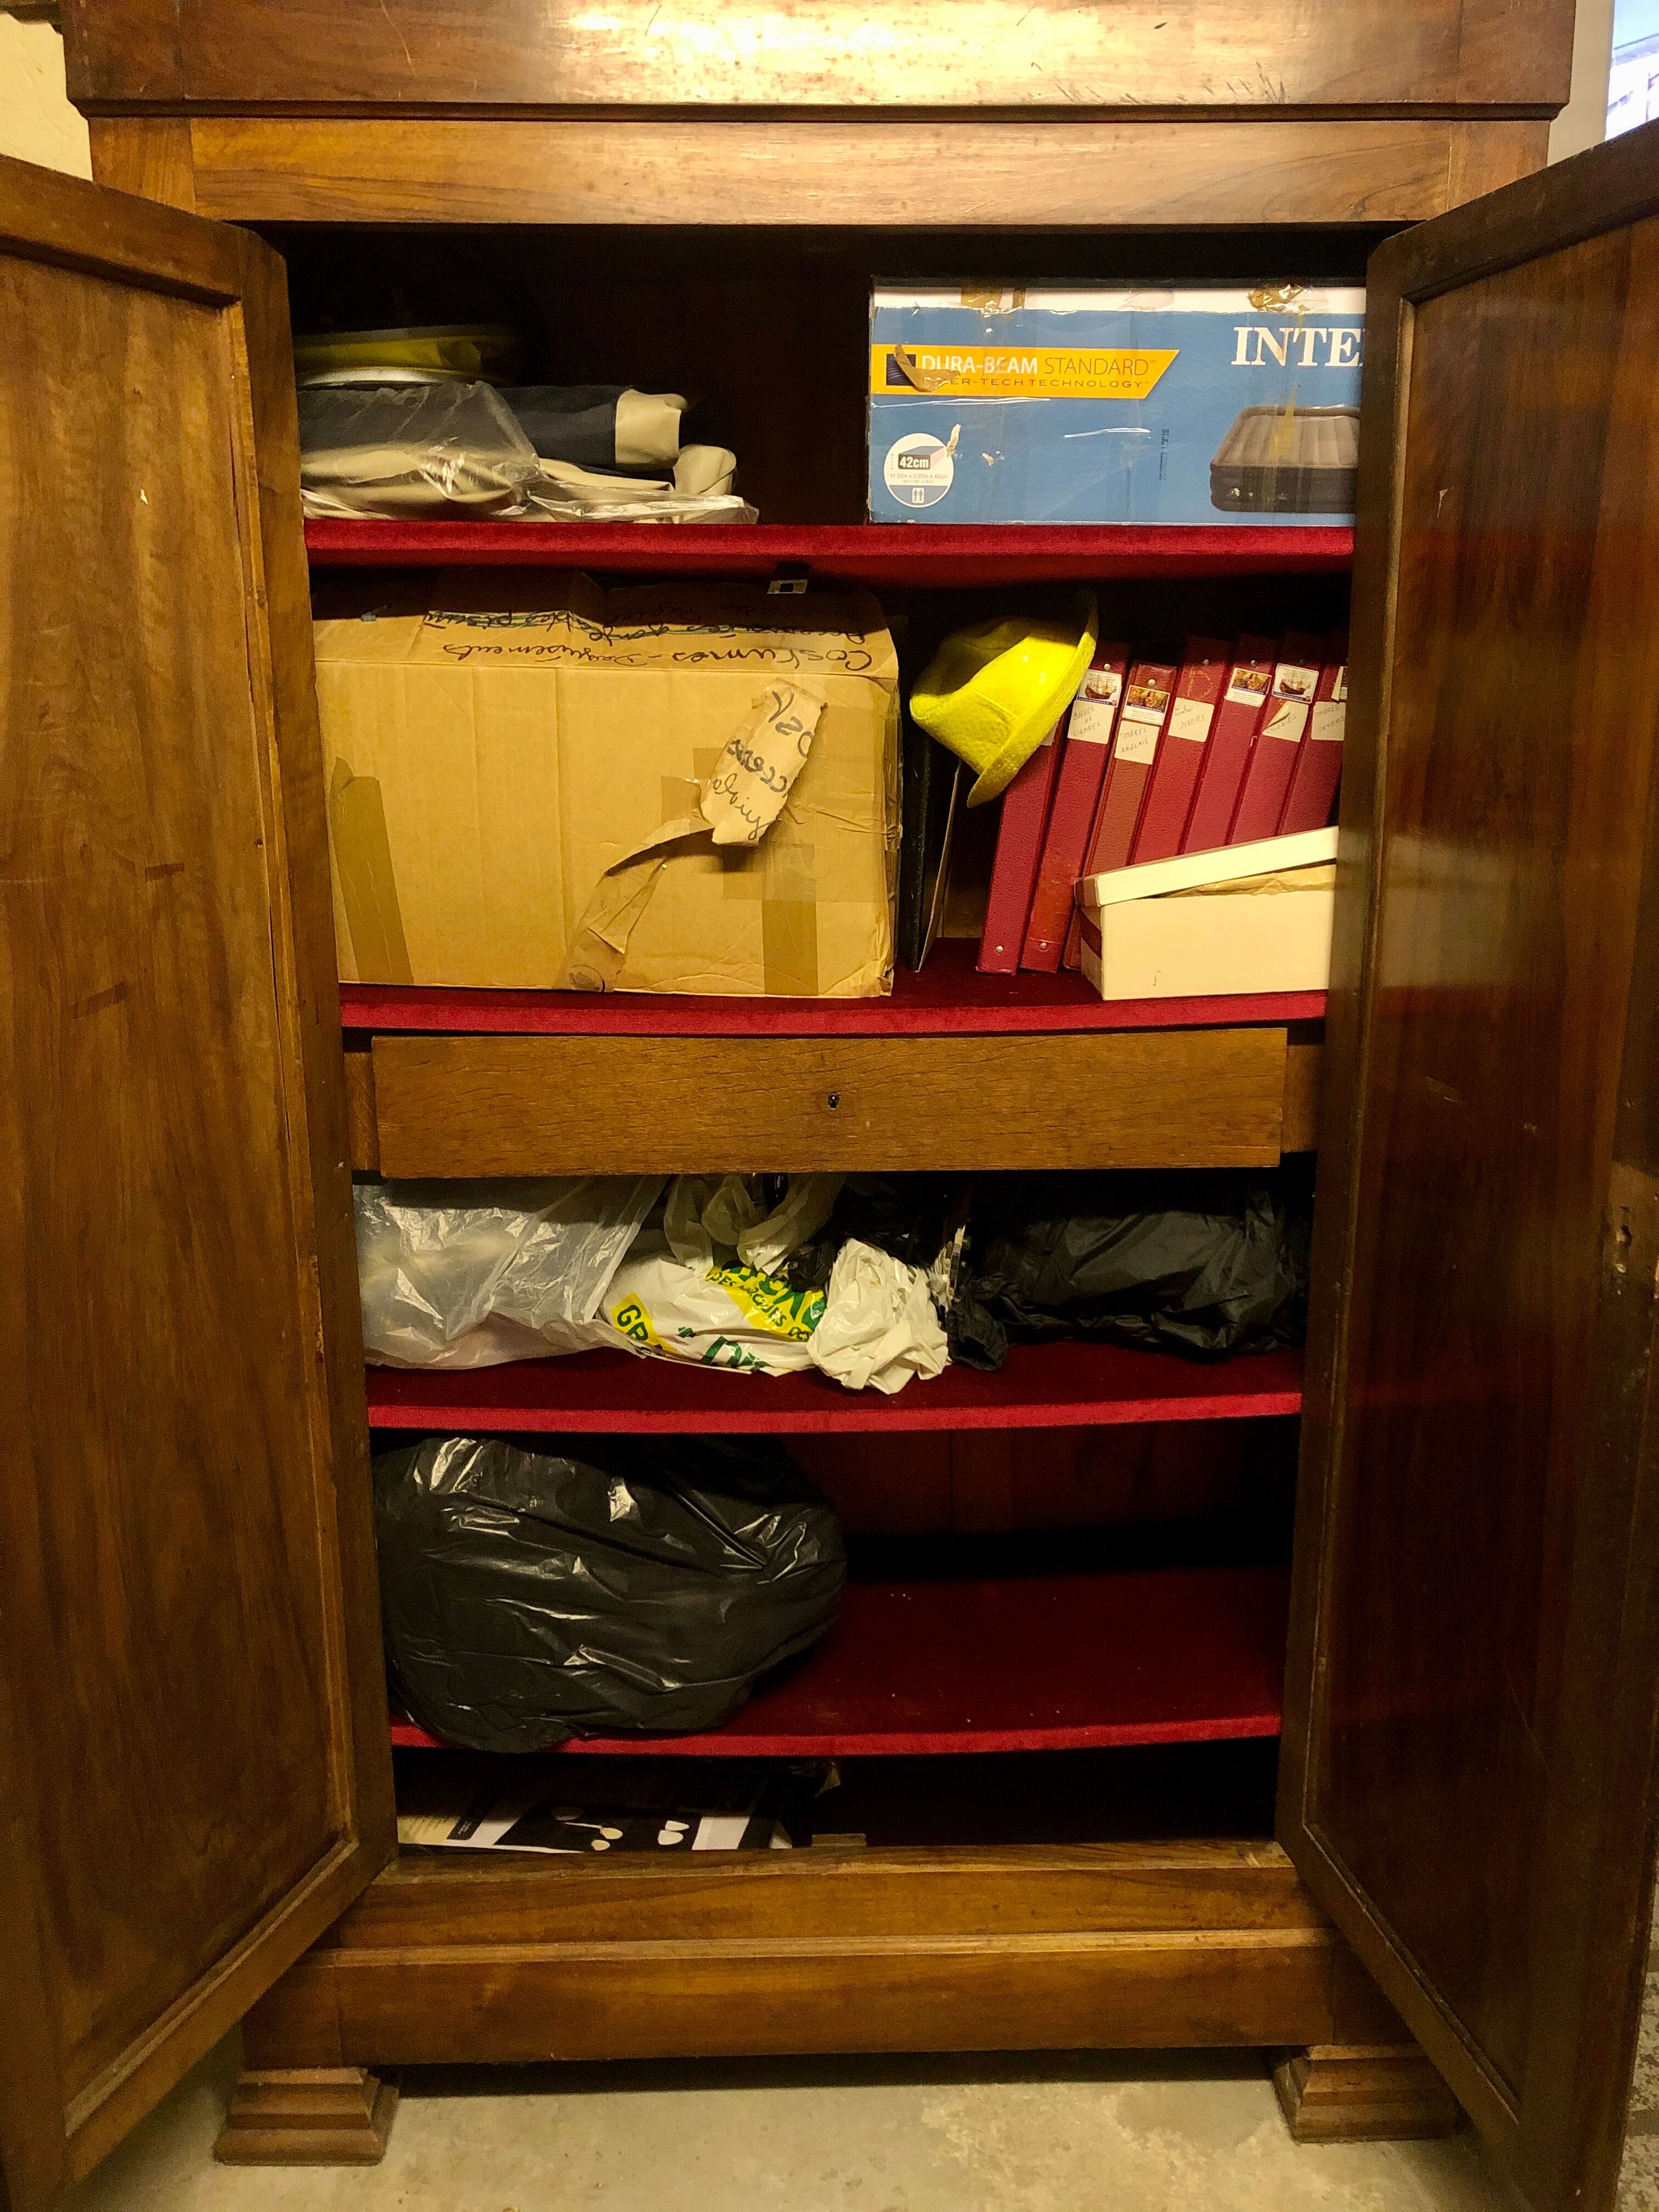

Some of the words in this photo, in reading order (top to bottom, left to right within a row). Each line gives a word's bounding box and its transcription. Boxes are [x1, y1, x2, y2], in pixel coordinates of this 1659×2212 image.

[1231, 326, 1363, 366] INTE
[922, 355, 1038, 375] DURA-BEAM
[950, 378, 1024, 386] ER-TECH
[899, 456, 929, 468] 42cm
[672, 648, 872, 672] Costumes
[1073, 721, 1101, 736] CIGARES
[1121, 737, 1149, 754] ANGLAIS
